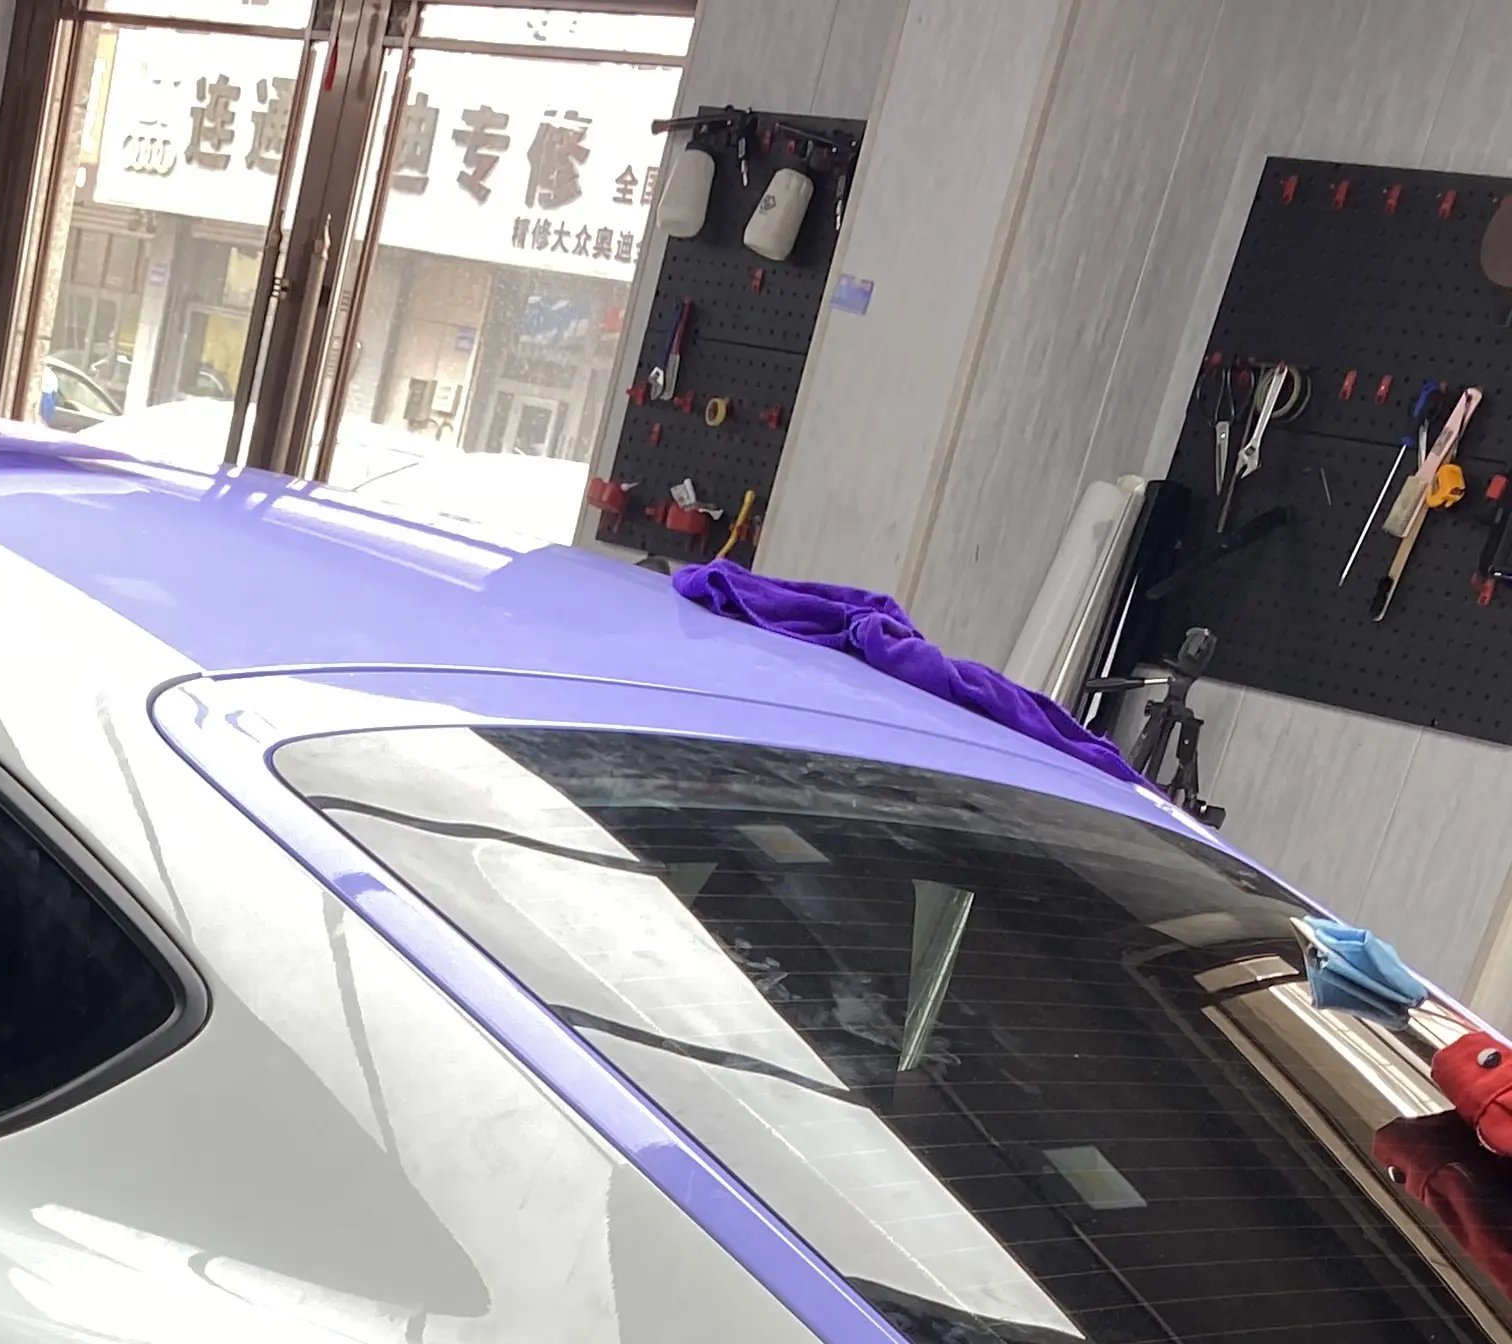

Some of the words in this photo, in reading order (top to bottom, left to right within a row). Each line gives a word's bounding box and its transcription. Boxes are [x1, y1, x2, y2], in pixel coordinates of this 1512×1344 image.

[511, 216, 642, 265] 精修大众奥迪
